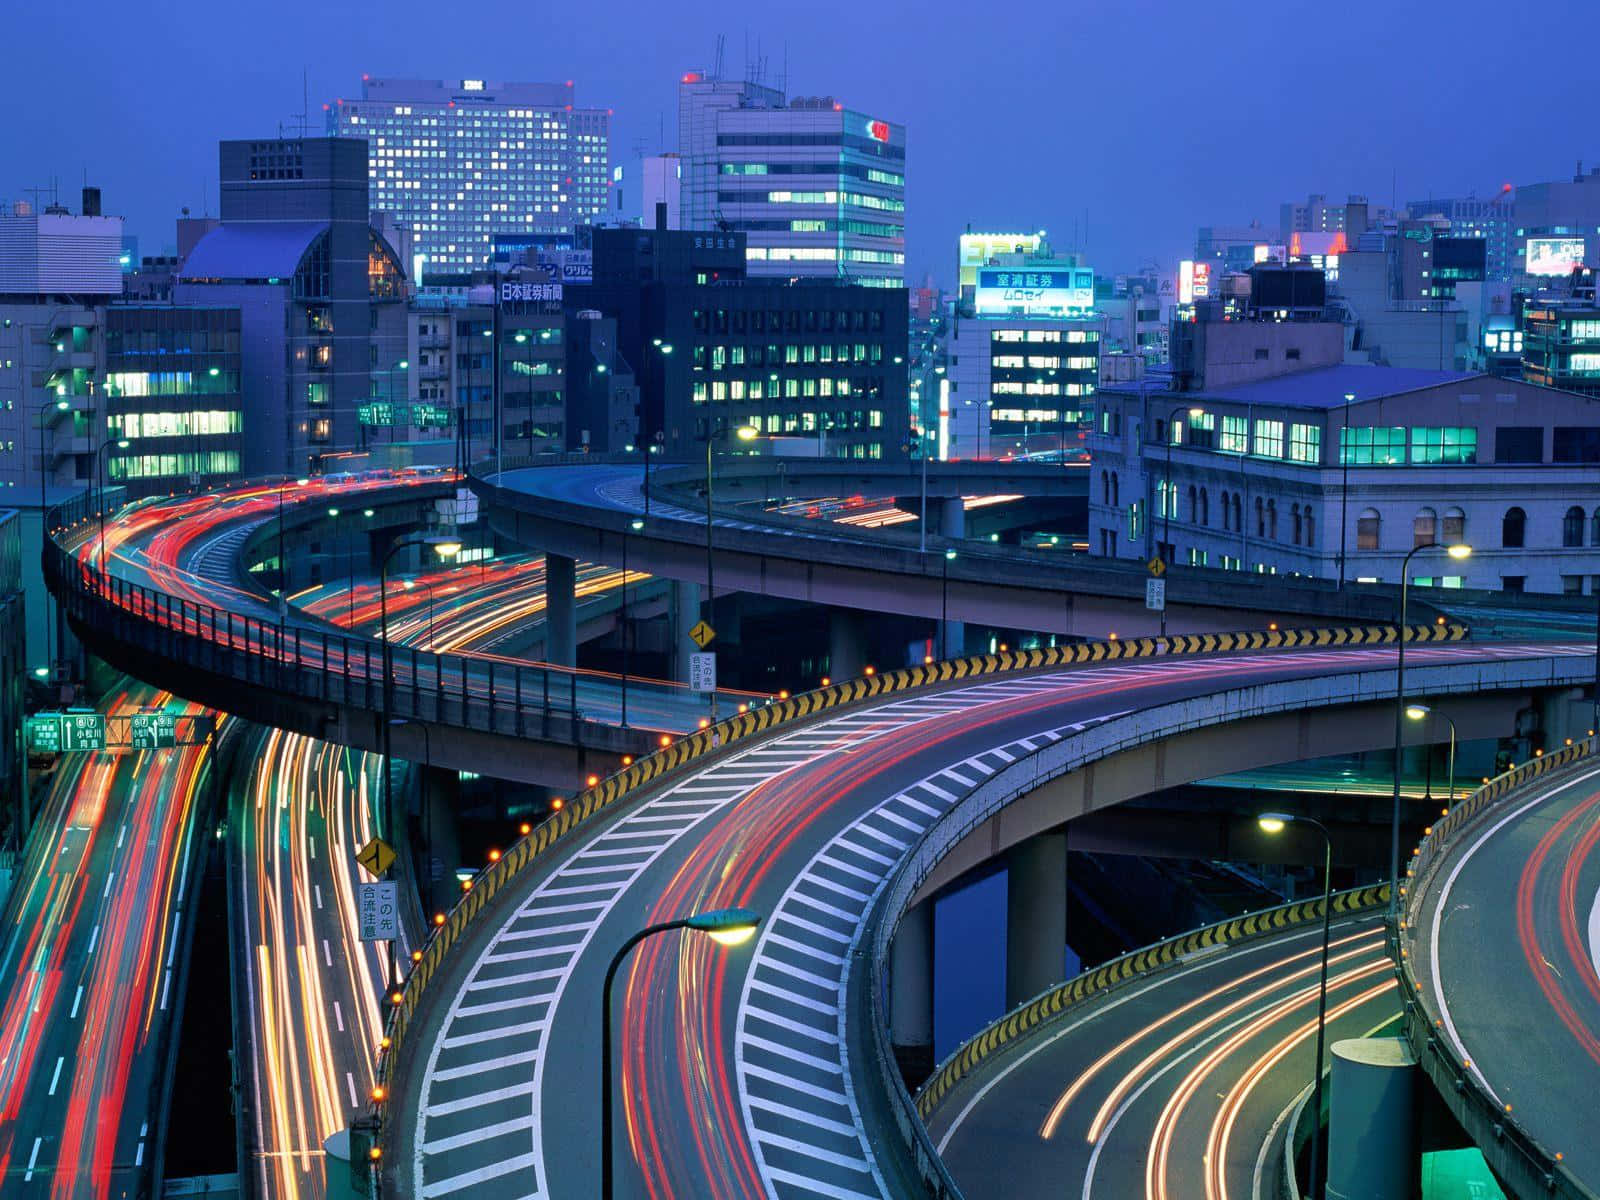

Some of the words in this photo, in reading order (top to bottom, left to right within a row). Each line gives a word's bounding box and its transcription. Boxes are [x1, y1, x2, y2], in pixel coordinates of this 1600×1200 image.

[502, 283, 563, 301] 日本証券新聞
[1003, 289, 1044, 301] ムロセイ
[76, 728, 102, 739] 小松川
[363, 886, 376, 938] 合流注意
[380, 889, 393, 931] この先
